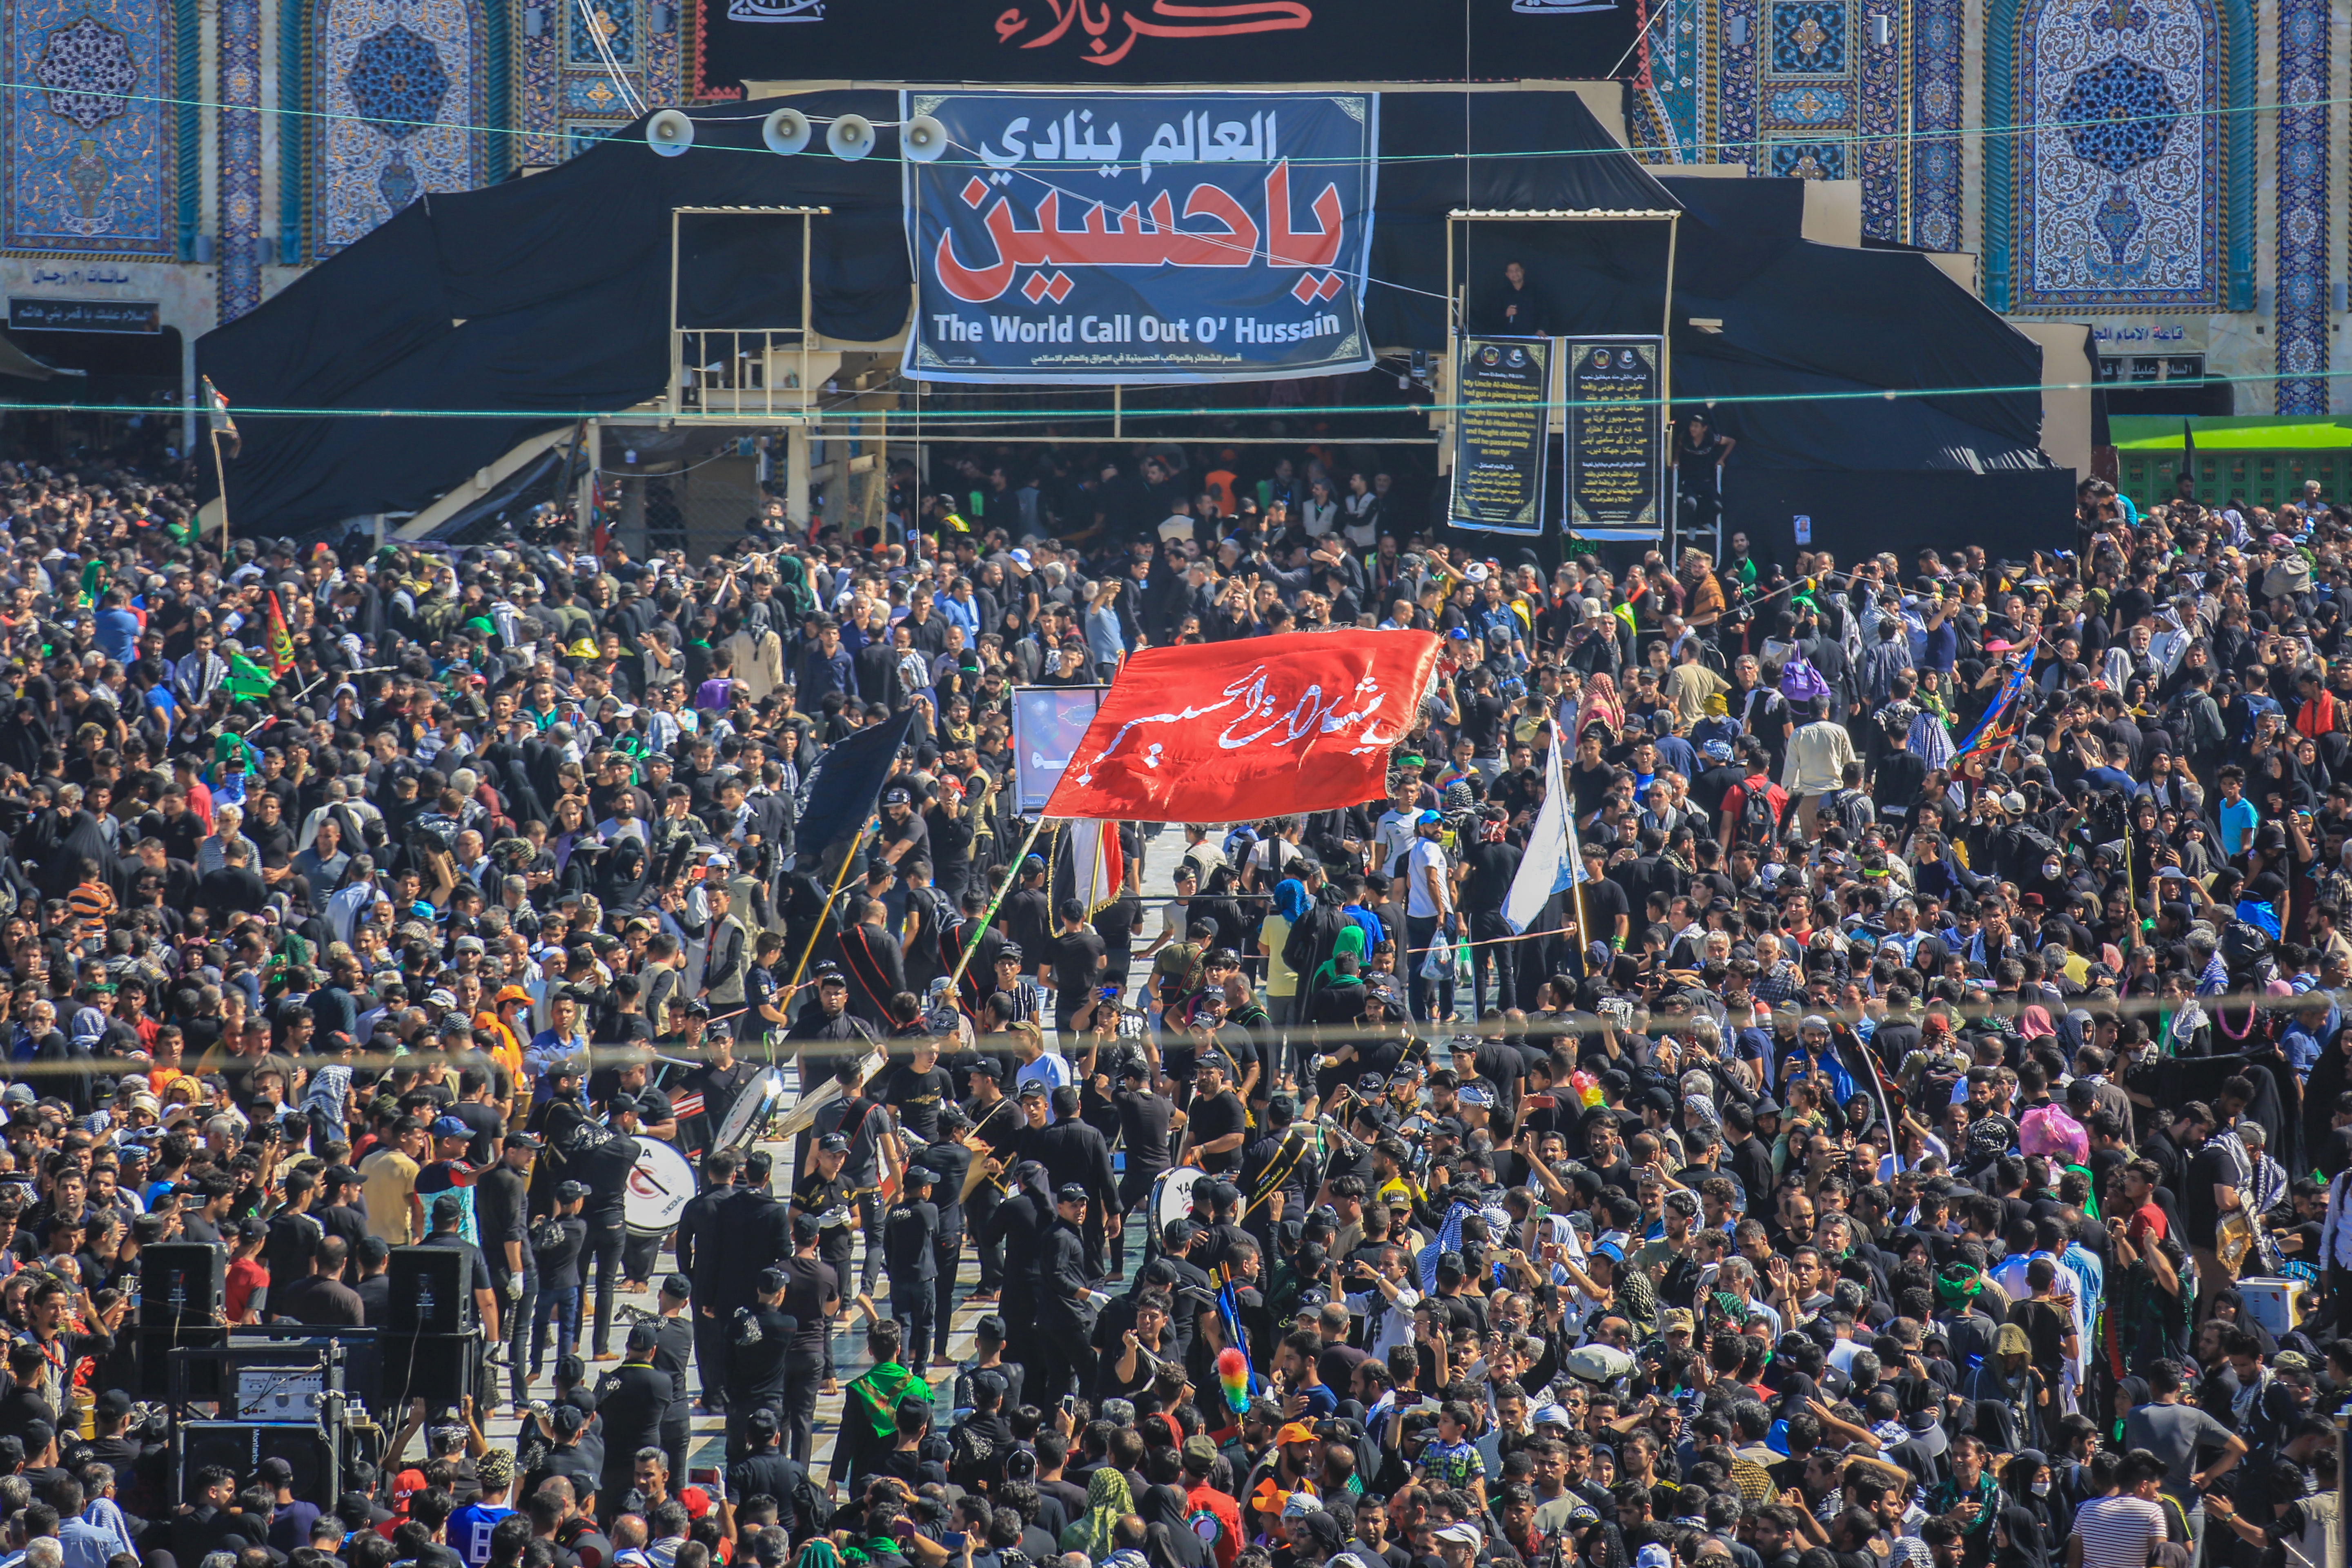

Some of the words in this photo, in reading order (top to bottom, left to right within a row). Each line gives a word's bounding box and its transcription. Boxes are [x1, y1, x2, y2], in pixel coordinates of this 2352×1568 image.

[995, 0, 1312, 65] كربلاء
[979, 108, 1123, 187] ينادي
[1139, 109, 1278, 185] العالم
[933, 314, 982, 342] The
[991, 315, 1073, 343] World
[1080, 314, 1132, 343] Call
[1139, 316, 1189, 343] Out
[1236, 310, 1340, 343] Hussain
[2153, 325, 2184, 340] قاعة
[2116, 326, 2149, 345] الامام
[1113, 353, 1125, 365] في
[1125, 354, 1160, 363] الحسينية
[1160, 354, 1194, 364] والمواكب
[1194, 354, 1221, 363] الشعائر
[1224, 353, 1242, 365] قسم
[252, 1429, 260, 1465] Montarbo
